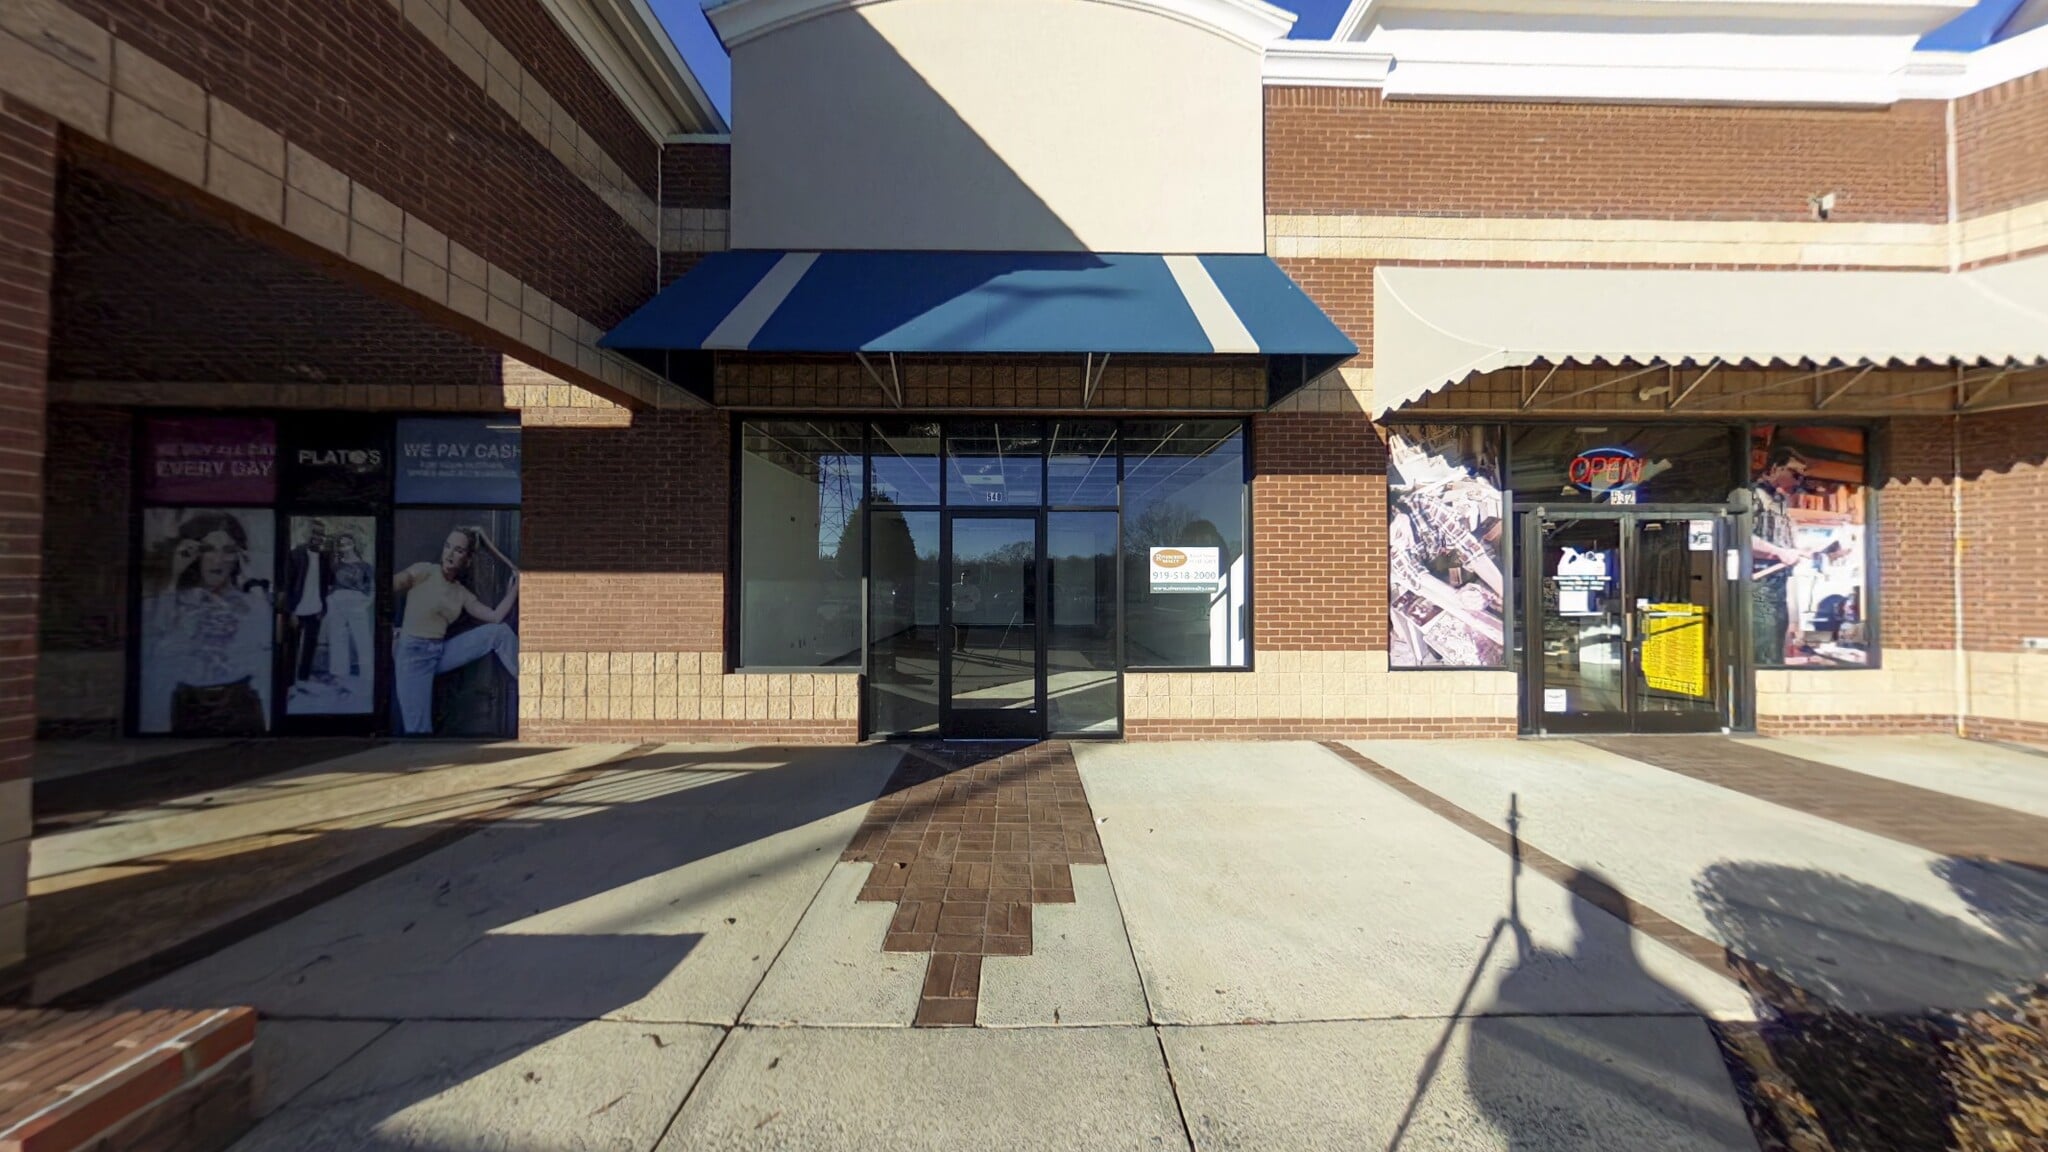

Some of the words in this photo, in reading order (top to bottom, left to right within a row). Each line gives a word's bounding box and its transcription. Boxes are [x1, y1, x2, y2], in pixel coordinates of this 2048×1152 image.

[404, 443, 432, 457] WE
[437, 443, 470, 457] PAY
[475, 443, 521, 458] CASH
[156, 460, 225, 477] EVERY
[230, 460, 274, 477] DAY
[1569, 457, 1646, 483] OPEN
[1611, 490, 1634, 504] 532
